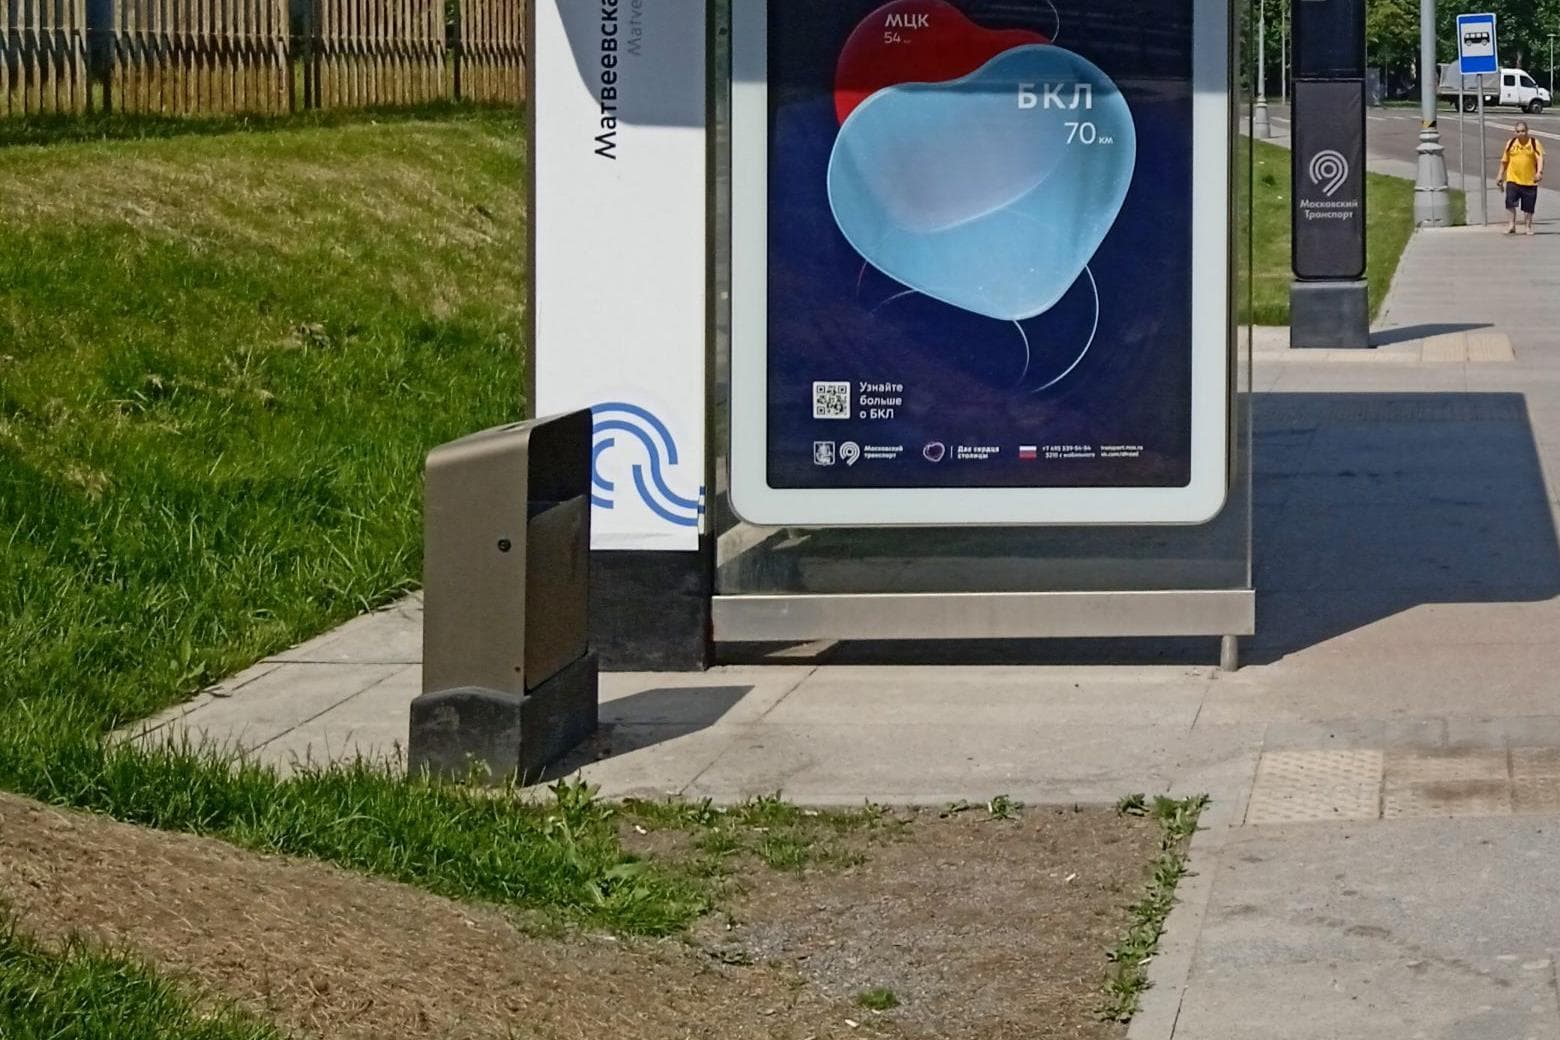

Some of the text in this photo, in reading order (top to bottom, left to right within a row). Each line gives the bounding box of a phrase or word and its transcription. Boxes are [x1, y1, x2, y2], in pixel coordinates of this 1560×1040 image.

[885, 13, 929, 29] МЦК
[884, 31, 901, 44] 54
[1017, 82, 1093, 110] БКЛ
[1064, 122, 1114, 144] 70 км
[1300, 199, 1358, 208] Московский
[1304, 210, 1353, 221] Транспорт
[859, 381, 904, 393] Узнайте
[859, 394, 903, 406] больше
[859, 408, 894, 419] о БКЛ
